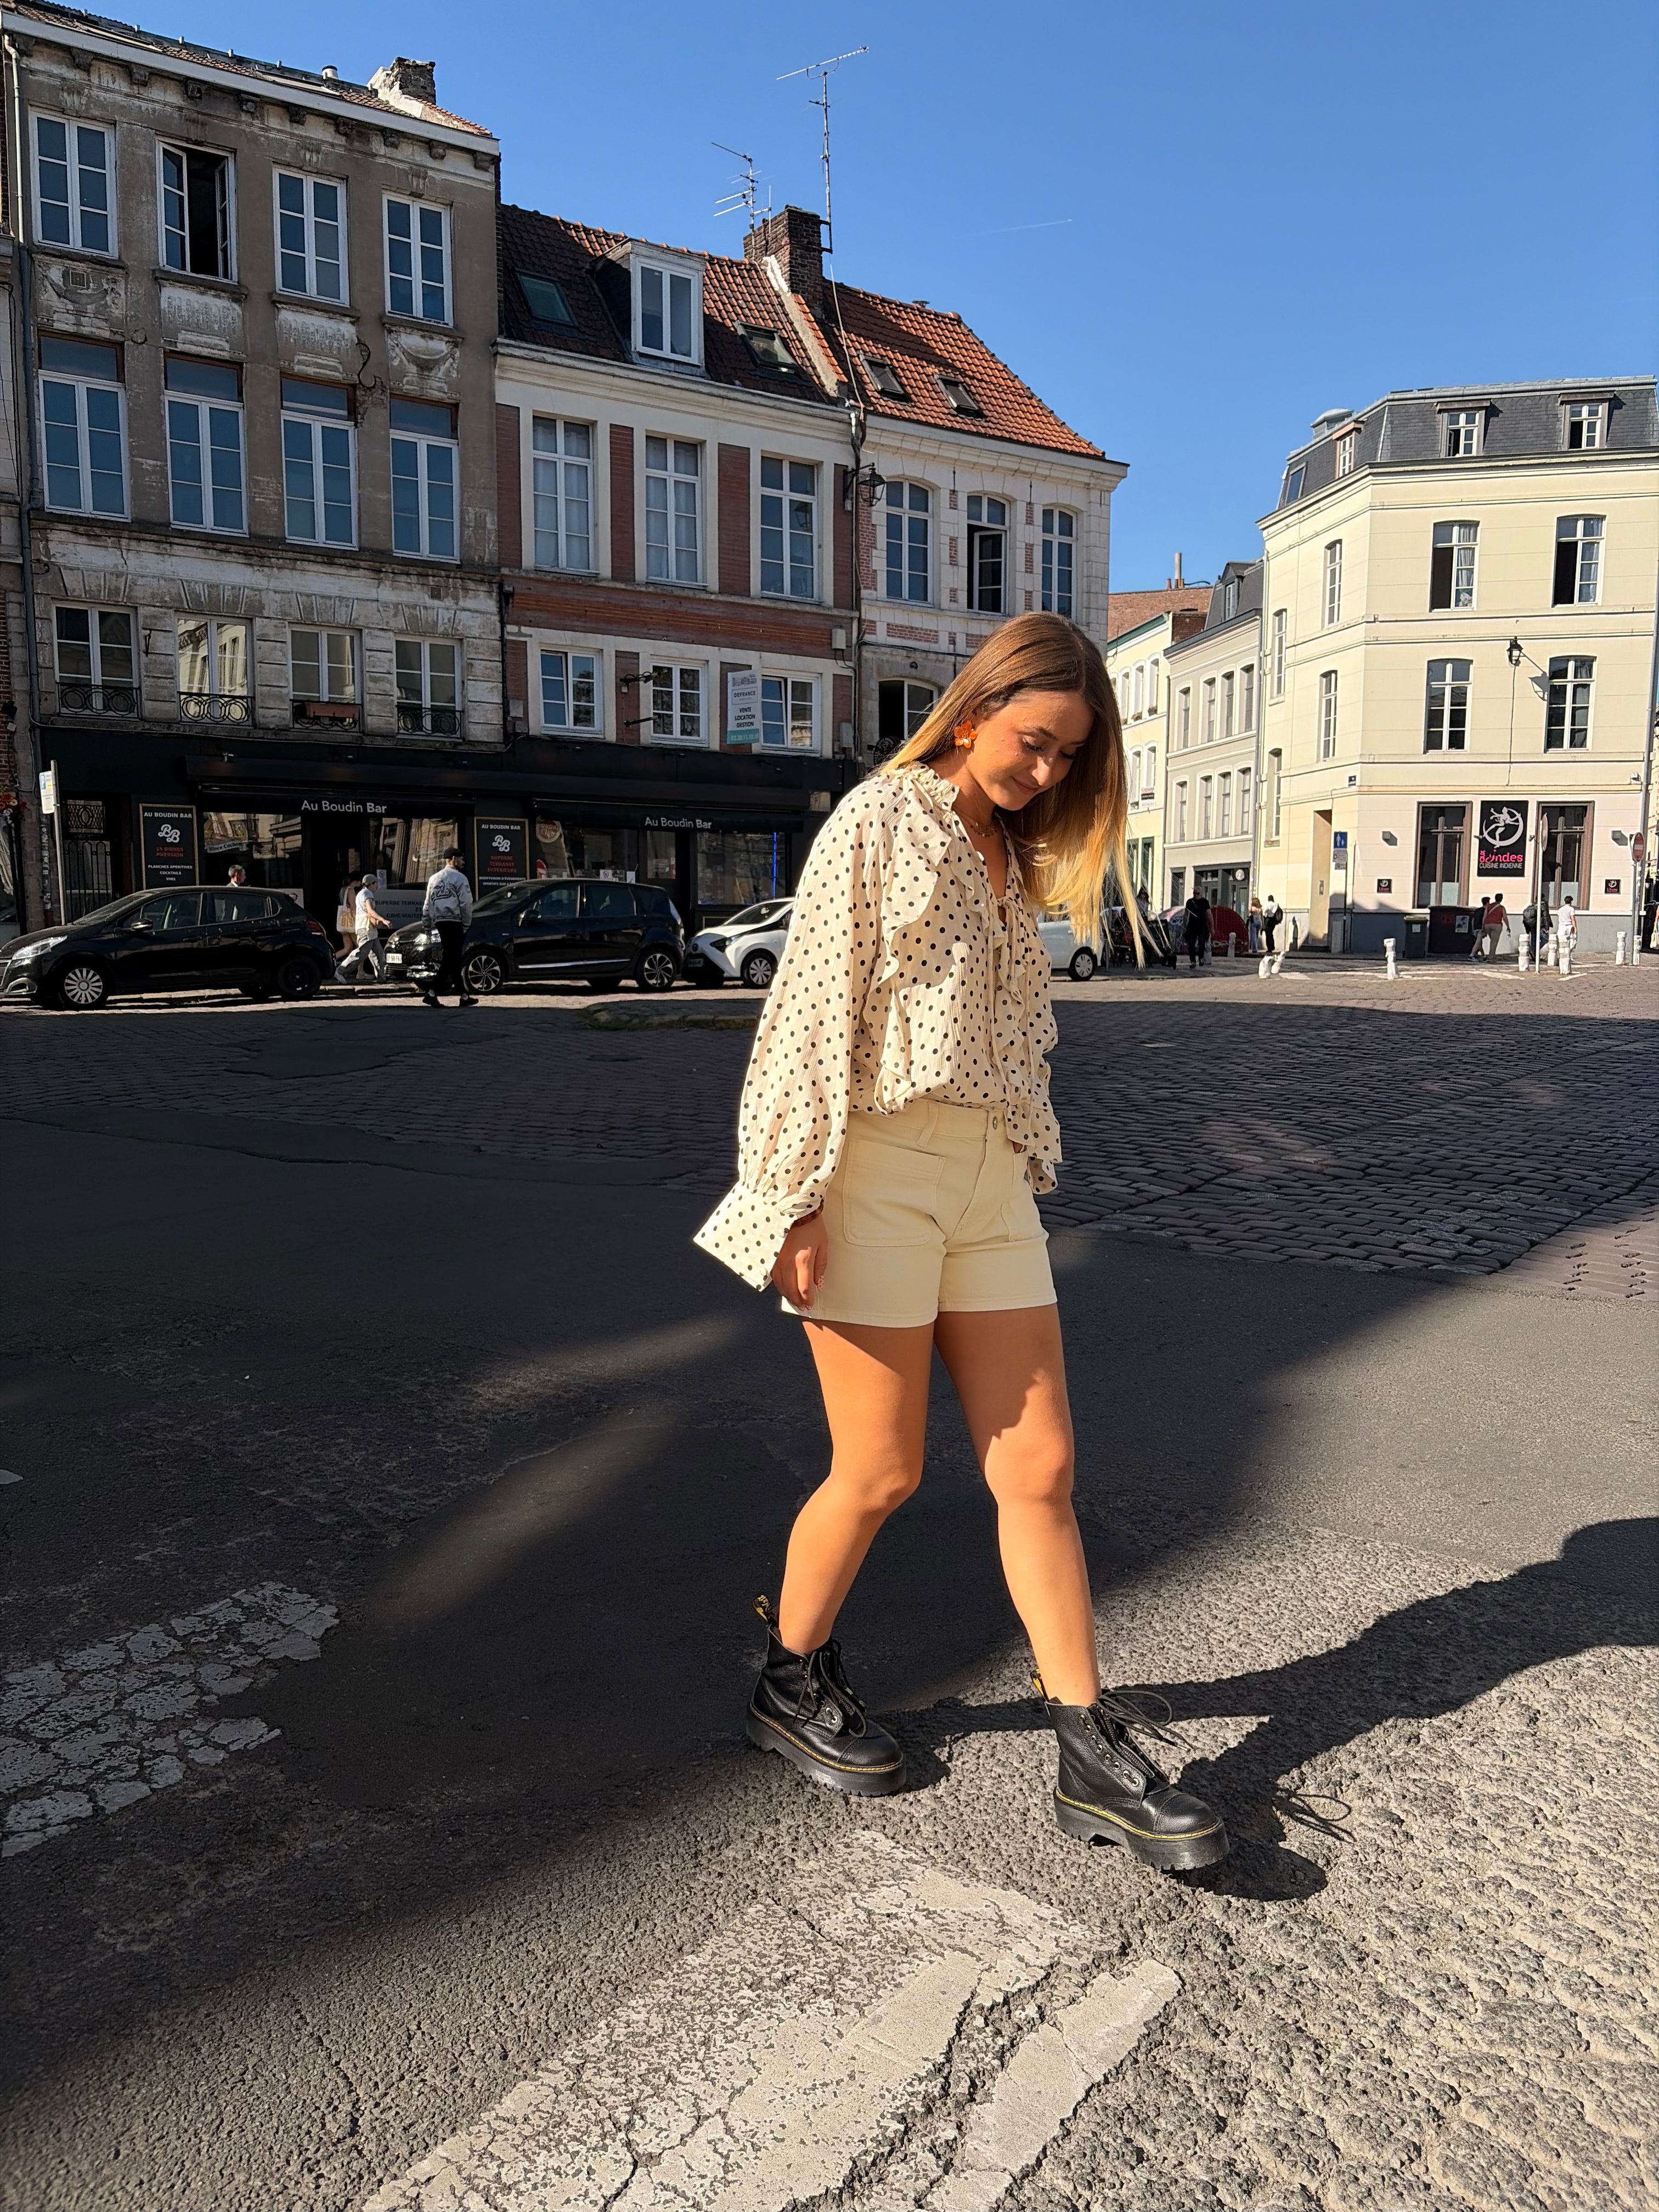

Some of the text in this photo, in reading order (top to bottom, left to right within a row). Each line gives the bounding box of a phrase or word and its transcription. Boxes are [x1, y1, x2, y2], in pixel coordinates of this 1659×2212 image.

[301, 800, 387, 813] Au Boudin Bar
[645, 817, 712, 829] Au Boudin Bar
